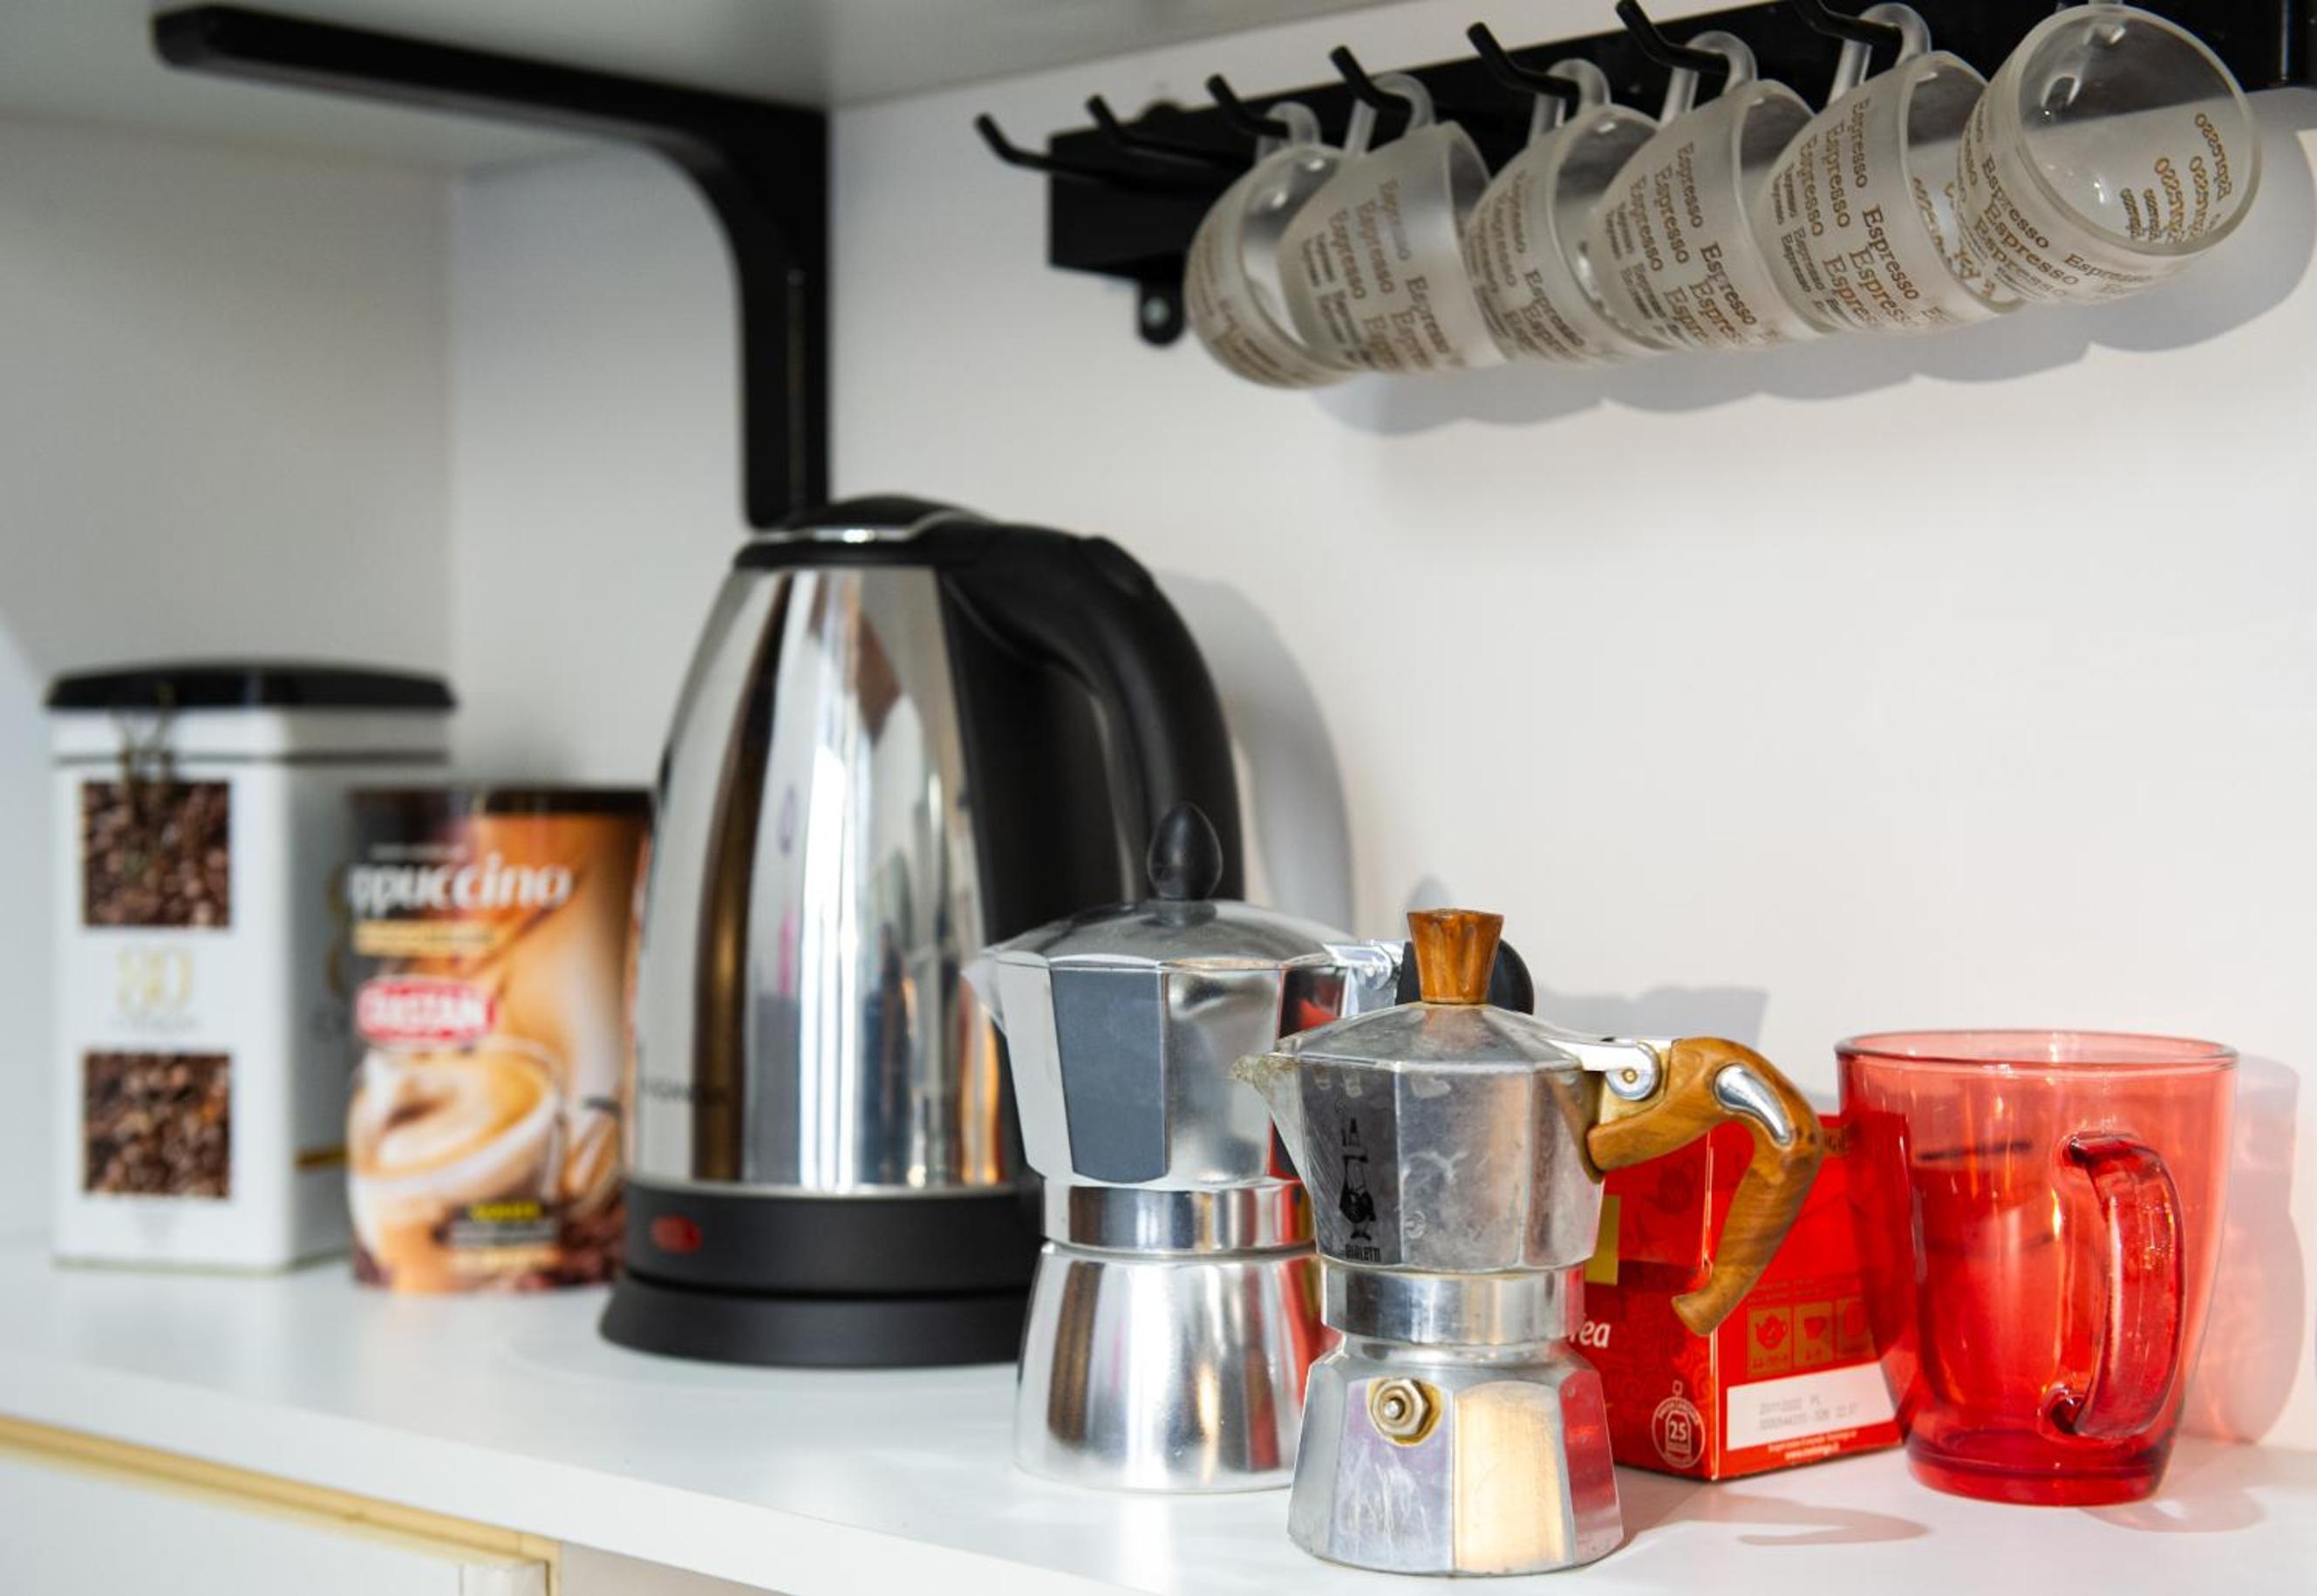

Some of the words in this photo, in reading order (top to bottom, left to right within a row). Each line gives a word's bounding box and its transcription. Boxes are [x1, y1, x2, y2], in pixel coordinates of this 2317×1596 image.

[1654, 163, 1689, 263] Espresso
[1823, 119, 1851, 228] Espresso
[1982, 153, 2049, 249] Espresso
[1700, 242, 1757, 326] Espresso
[1862, 203, 1920, 301] Espresso
[1984, 200, 2080, 285] Espresso
[1569, 1320, 1612, 1348] ea
[1669, 1420, 1687, 1442] 25
